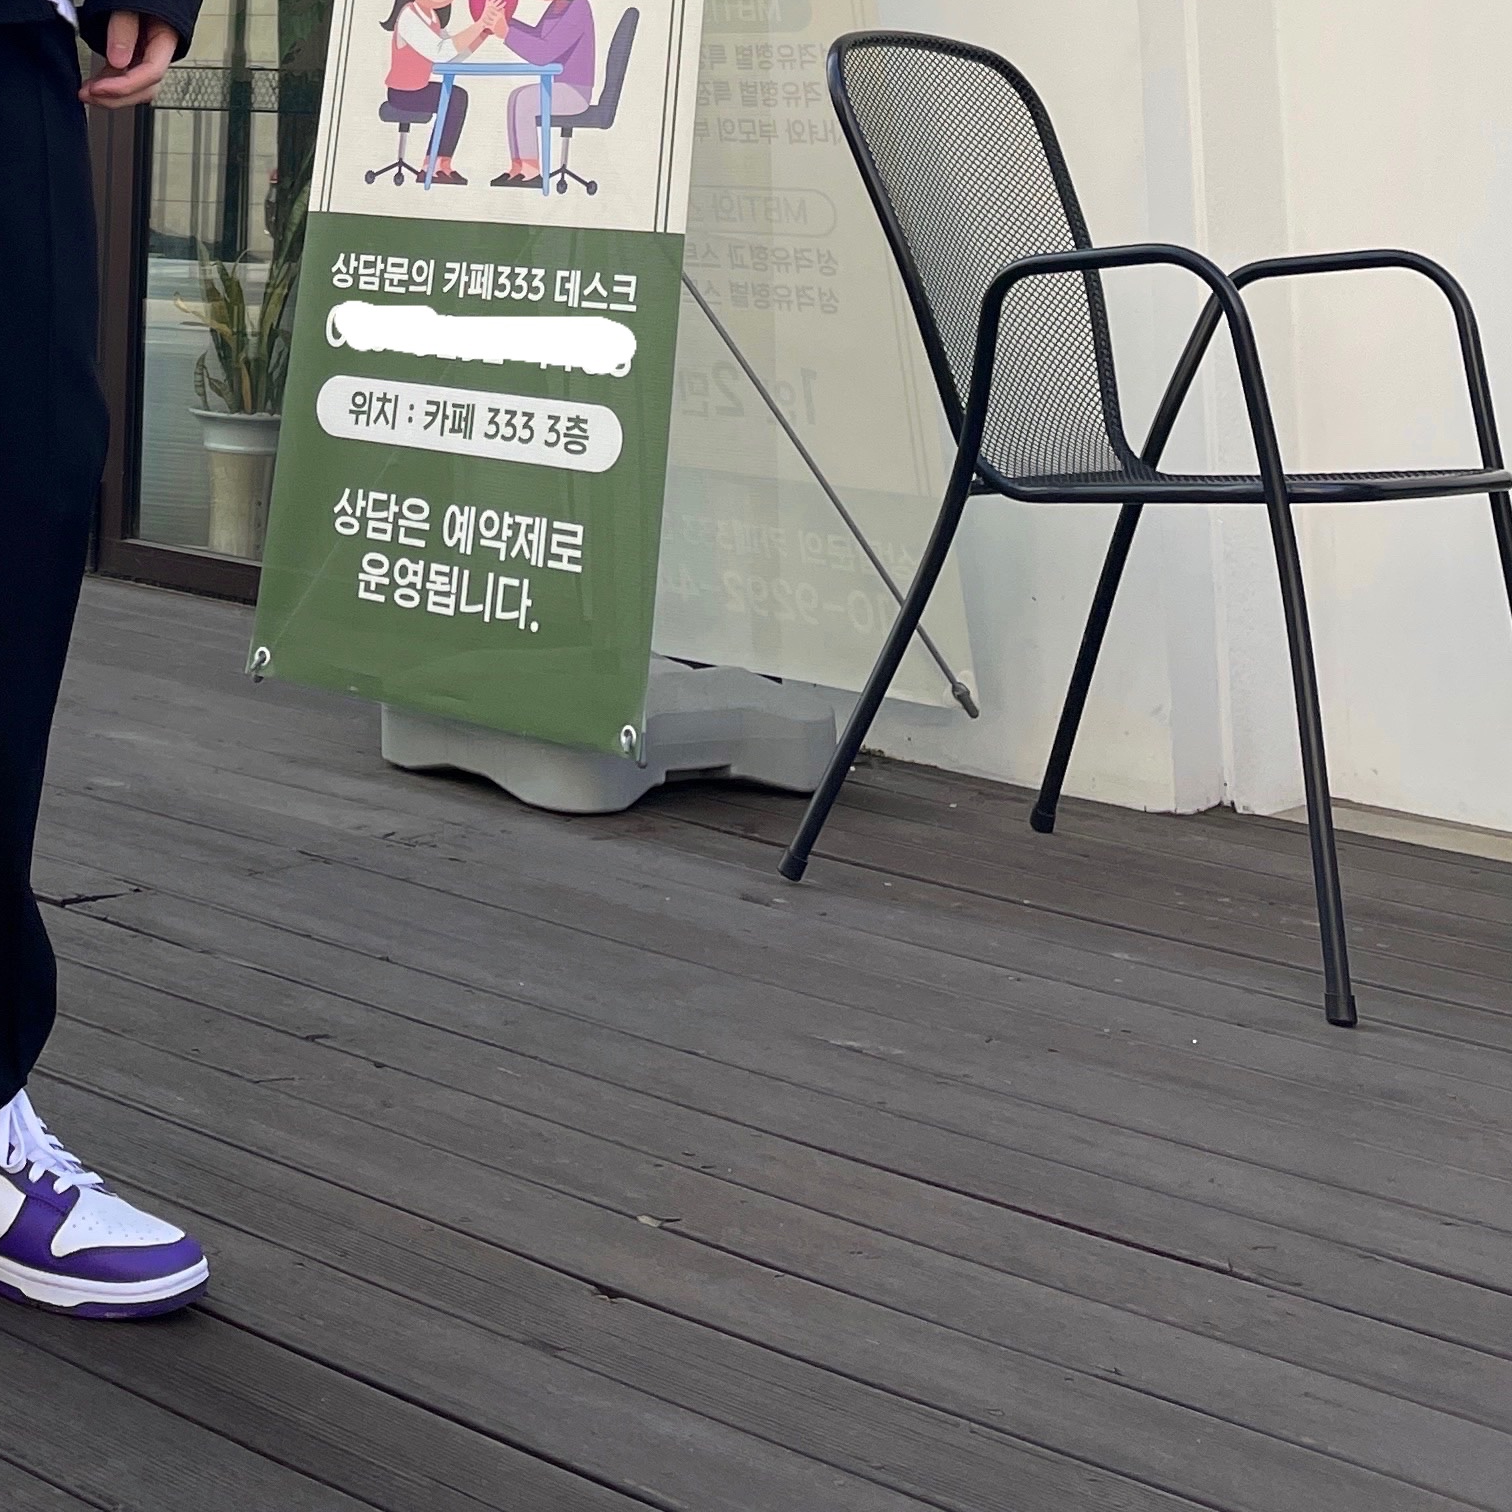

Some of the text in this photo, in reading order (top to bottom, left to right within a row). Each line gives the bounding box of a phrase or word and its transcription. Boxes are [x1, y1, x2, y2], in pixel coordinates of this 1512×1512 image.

[330, 252, 638, 312] 상담문의 카페333 데스크
[348, 390, 399, 430] 위치
[423, 398, 476, 440] 카페
[483, 407, 535, 445] 333
[543, 414, 590, 456] 3층
[333, 487, 583, 573] 상담은 예약제로
[358, 551, 539, 633] 운영됩니다.
